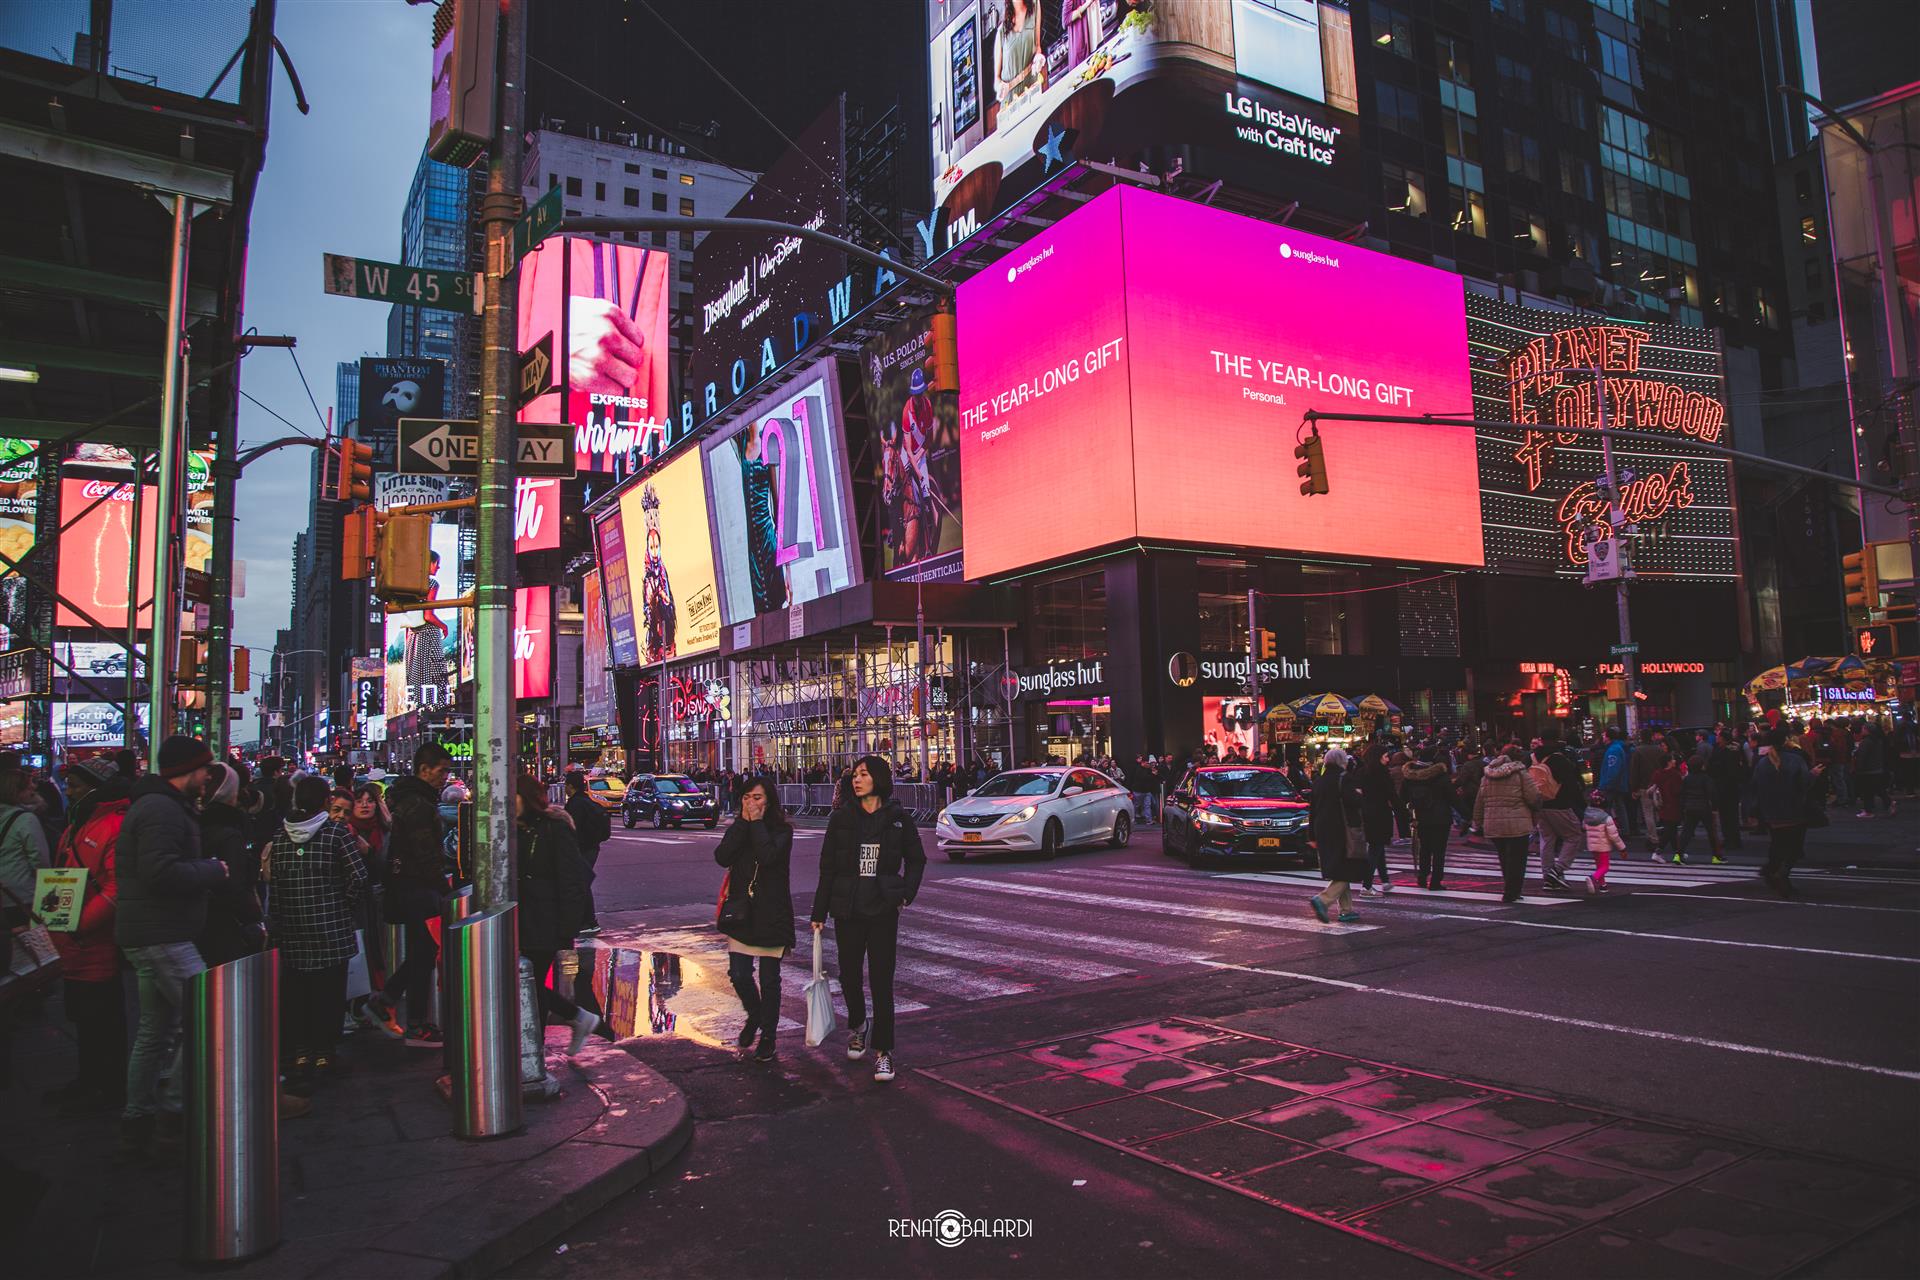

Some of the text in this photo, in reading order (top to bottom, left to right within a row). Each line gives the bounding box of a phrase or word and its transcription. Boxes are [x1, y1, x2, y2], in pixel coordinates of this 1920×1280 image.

[1225, 91, 1253, 119] LG
[1236, 126, 1263, 144] with
[1264, 129, 1307, 158] Craft
[525, 217, 532, 247] 7
[1016, 244, 1055, 276] sunglass hut
[1292, 248, 1340, 269] sunglass hut
[363, 265, 472, 302] W 45 St
[703, 266, 750, 334] Disneyland
[741, 311, 755, 330] NOW
[755, 298, 770, 319] OPEN
[896, 340, 917, 360] POLO
[375, 364, 432, 374] PHANTOM
[525, 355, 544, 388] WAY
[900, 357, 914, 370] SINCE
[962, 337, 1124, 430] THE YEAR-LONG GIFT
[1210, 350, 1414, 408] THE YEAR-LONG GIFT
[590, 393, 649, 409] EXPRESS
[1243, 387, 1287, 405] Personal.
[980, 421, 1011, 442] Personal.
[427, 437, 553, 461] ONE AY
[383, 474, 445, 493] LITTLE SHOP
[761, 396, 838, 566] 21
[12, 498, 37, 506] WITH
[1020, 661, 1104, 696] sunglass hut
[1281, 656, 1312, 680] hut
[1641, 662, 1705, 674] HOLLYWOOD
[670, 675, 713, 730] Disney
[71, 721, 107, 730] urban
[95, 710, 113, 720] the
